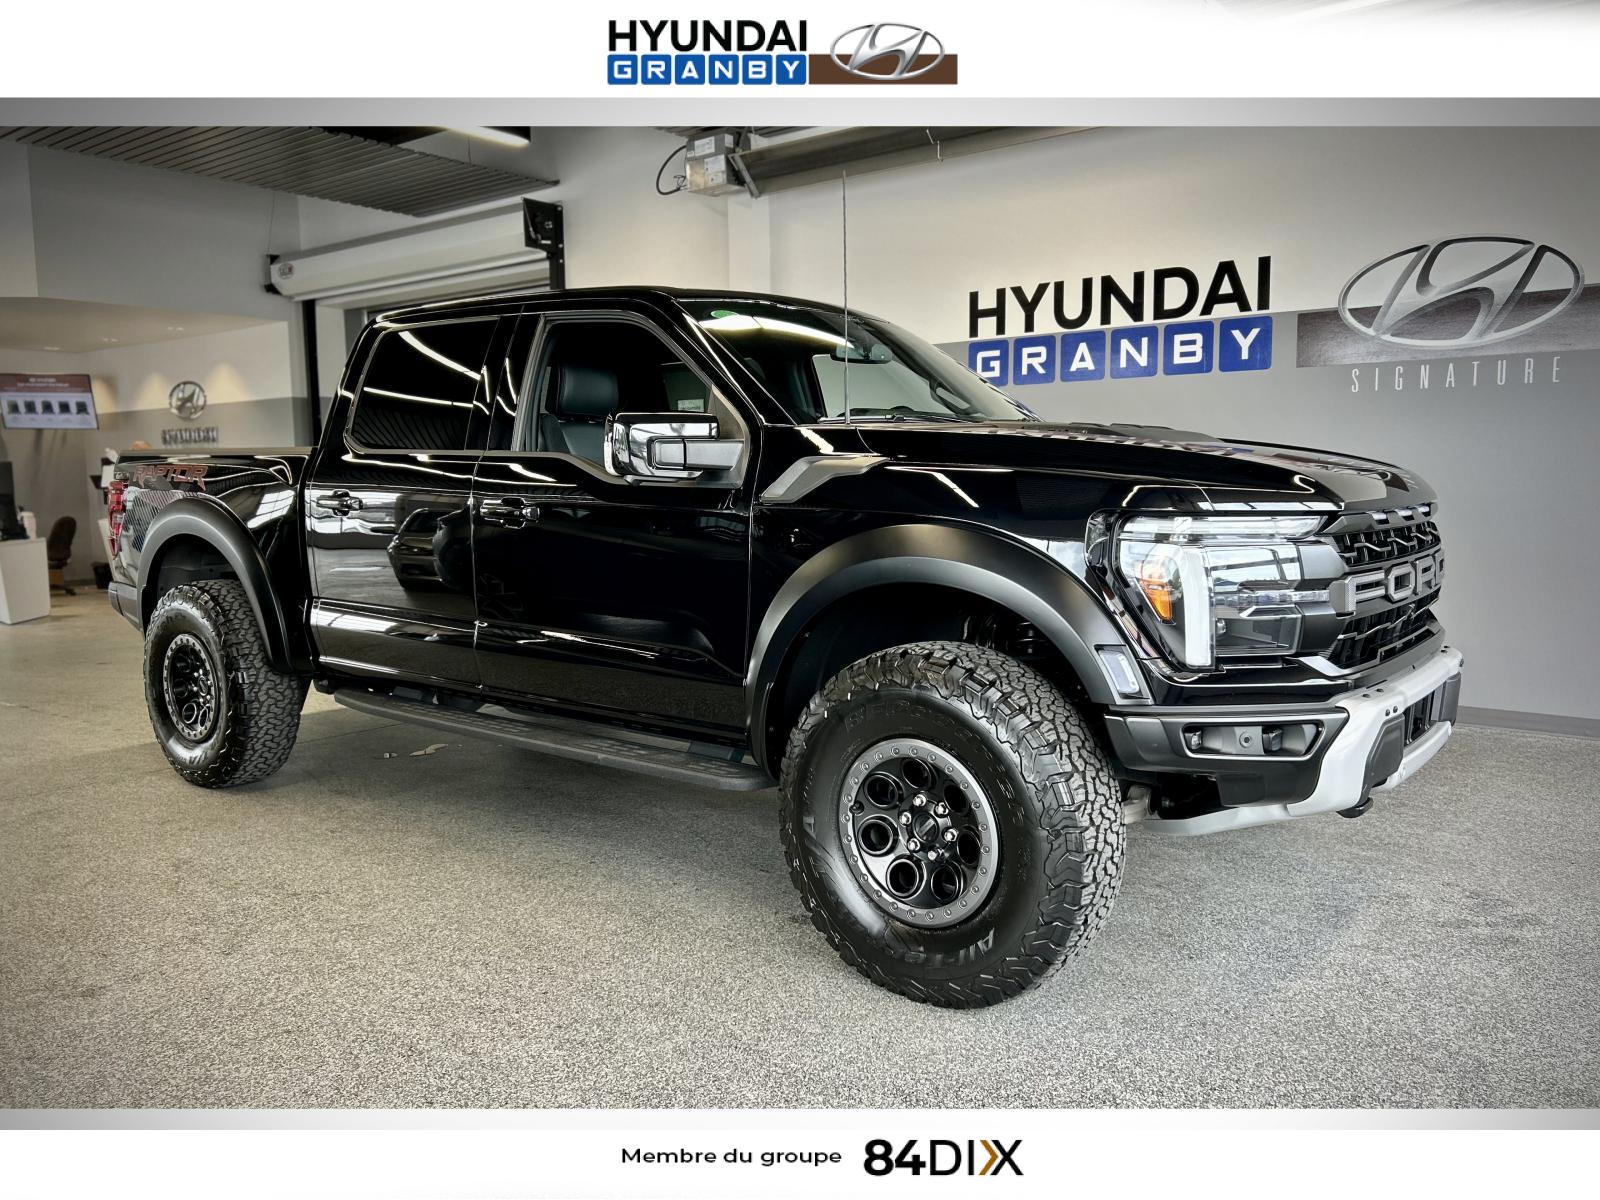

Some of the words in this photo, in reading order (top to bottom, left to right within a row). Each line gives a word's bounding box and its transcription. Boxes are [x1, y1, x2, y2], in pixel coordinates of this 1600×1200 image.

[968, 255, 1272, 338] HYUNDAI
[976, 326, 1259, 378] GRANBY
[1351, 356, 1561, 392] SIGNATURE
[133, 464, 208, 491] RAPTOR
[1344, 549, 1445, 613] FORD
